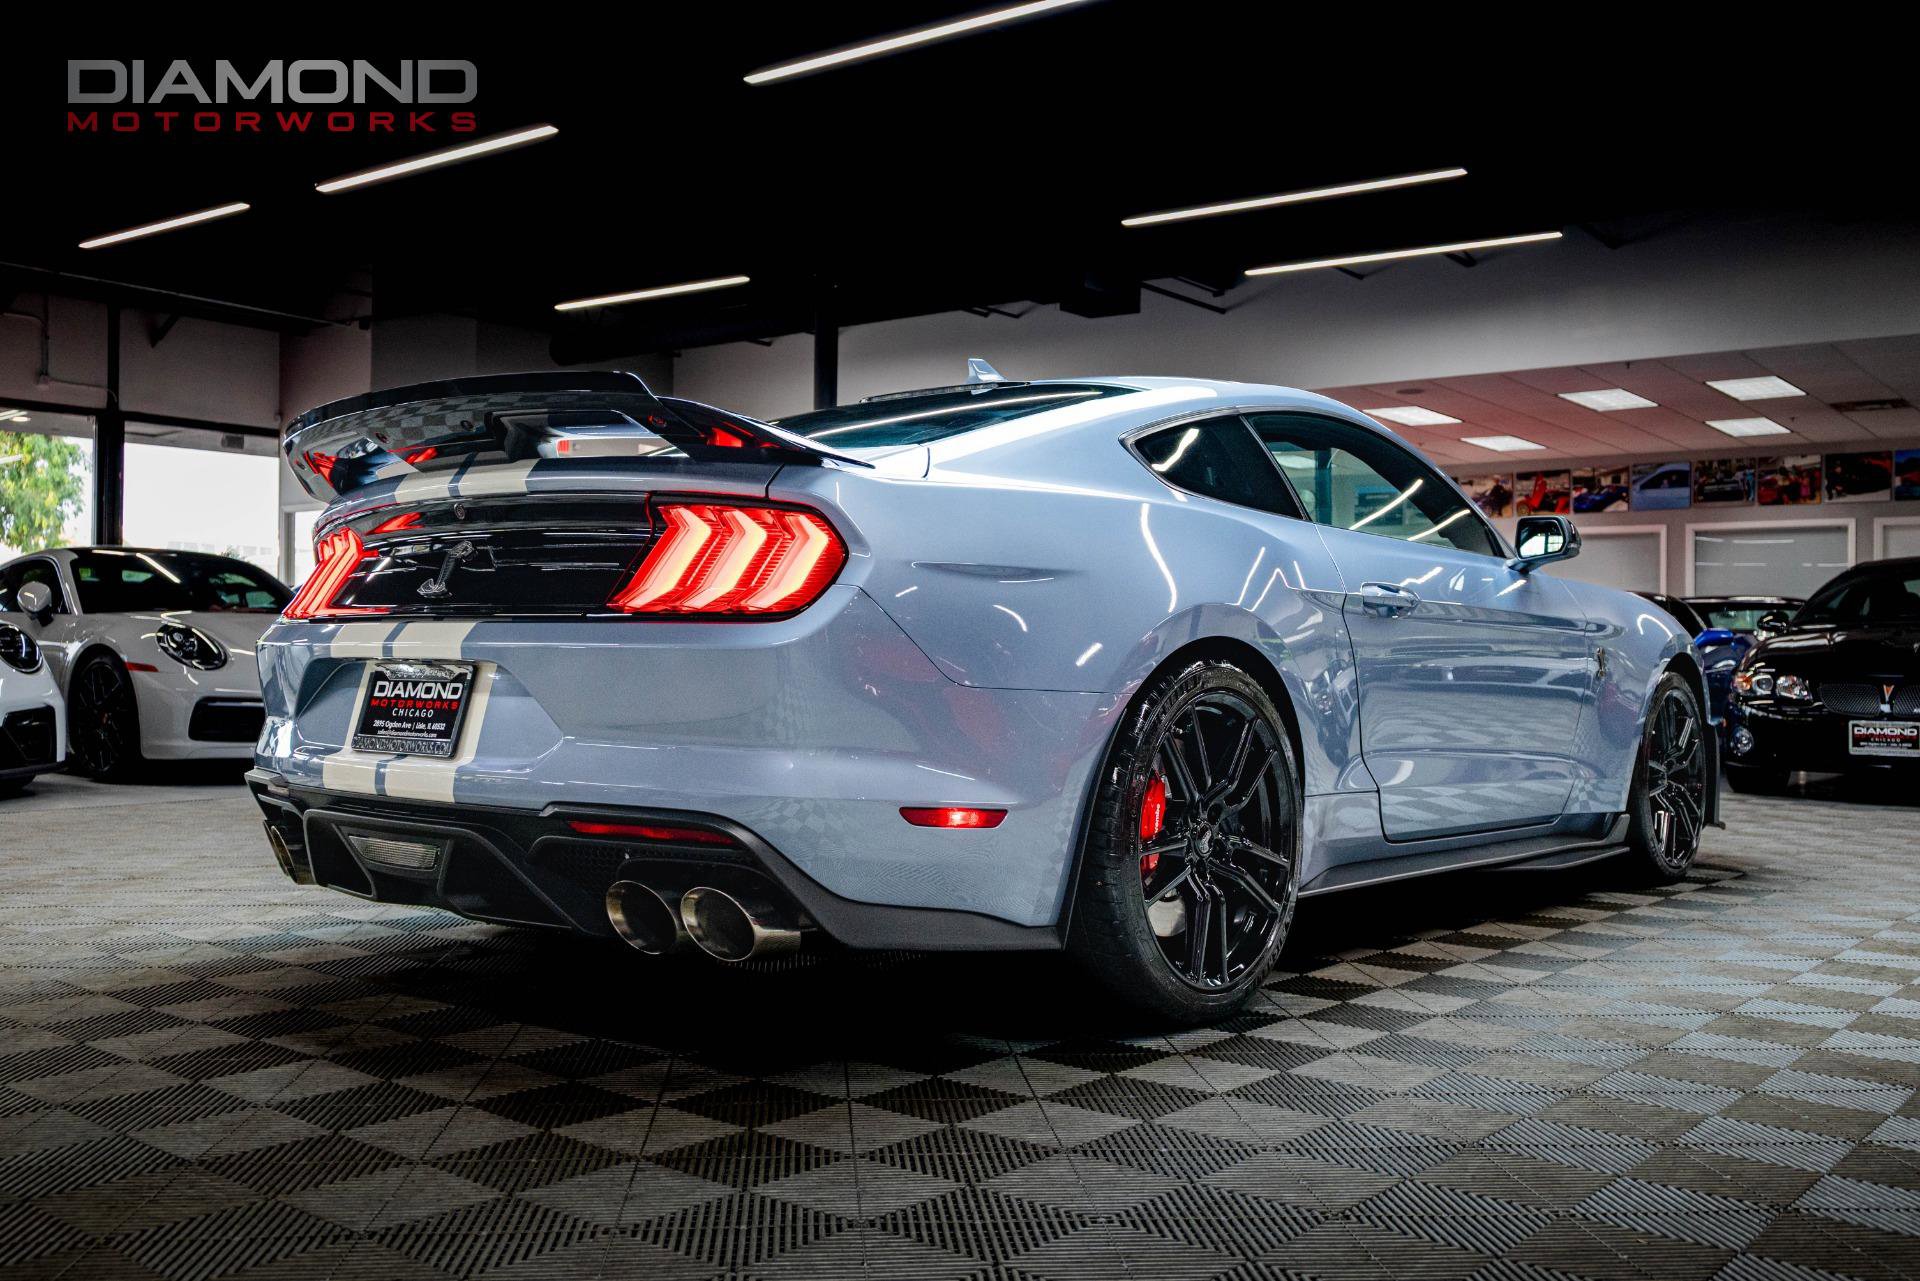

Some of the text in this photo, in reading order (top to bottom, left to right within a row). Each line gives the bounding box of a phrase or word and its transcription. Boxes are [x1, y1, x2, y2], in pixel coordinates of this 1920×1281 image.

[373, 681, 464, 700] DIAMOND
[370, 699, 460, 710] MOTORWORKS
[392, 708, 434, 718] CHICAGO
[402, 721, 412, 729] Ave
[1854, 726, 1918, 736] DIAMOND
